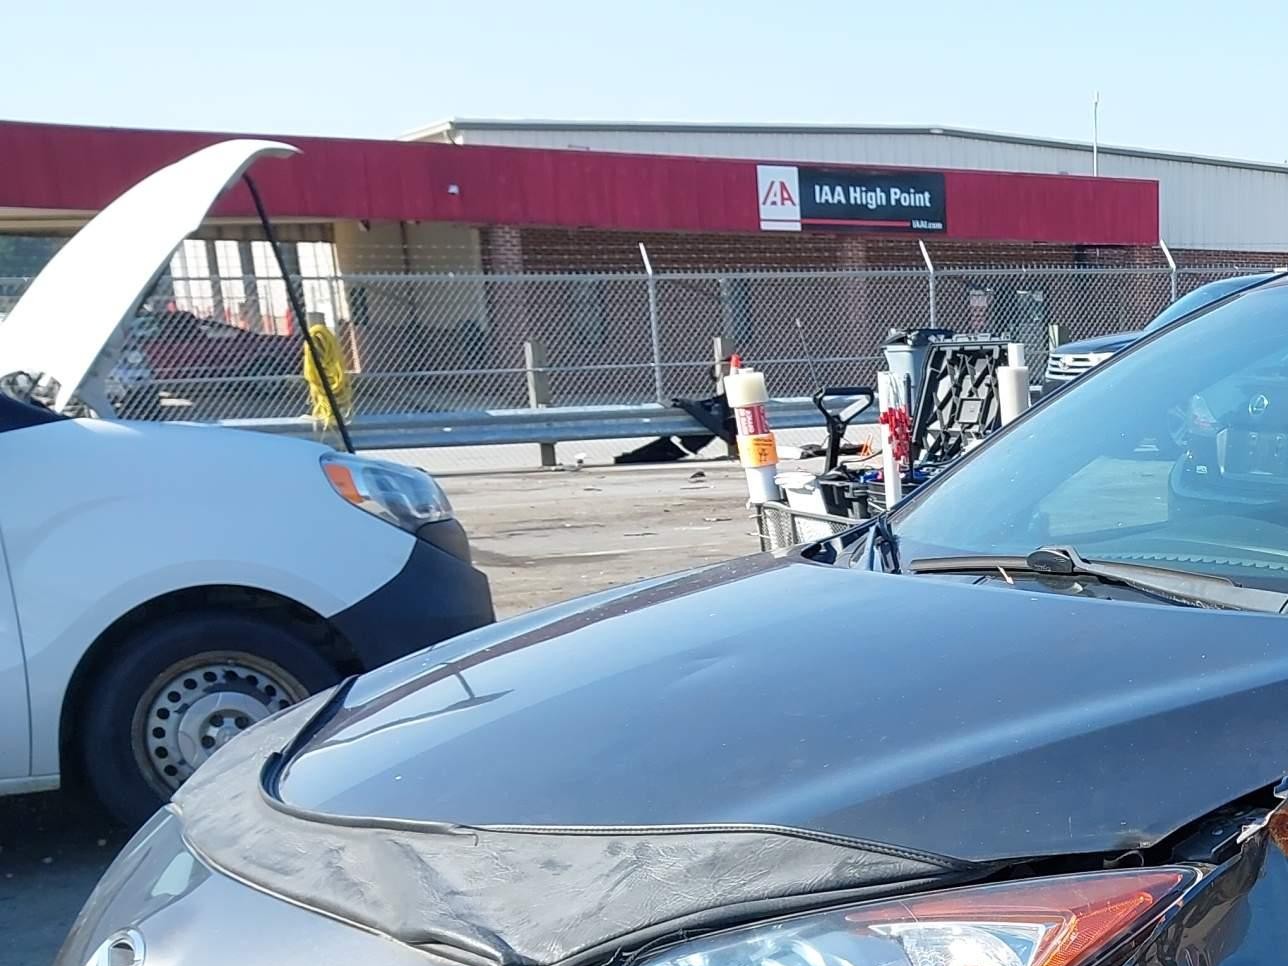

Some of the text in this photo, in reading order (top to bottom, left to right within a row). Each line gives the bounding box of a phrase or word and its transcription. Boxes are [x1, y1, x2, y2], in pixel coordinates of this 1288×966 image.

[814, 184, 932, 209] IAA High Point
